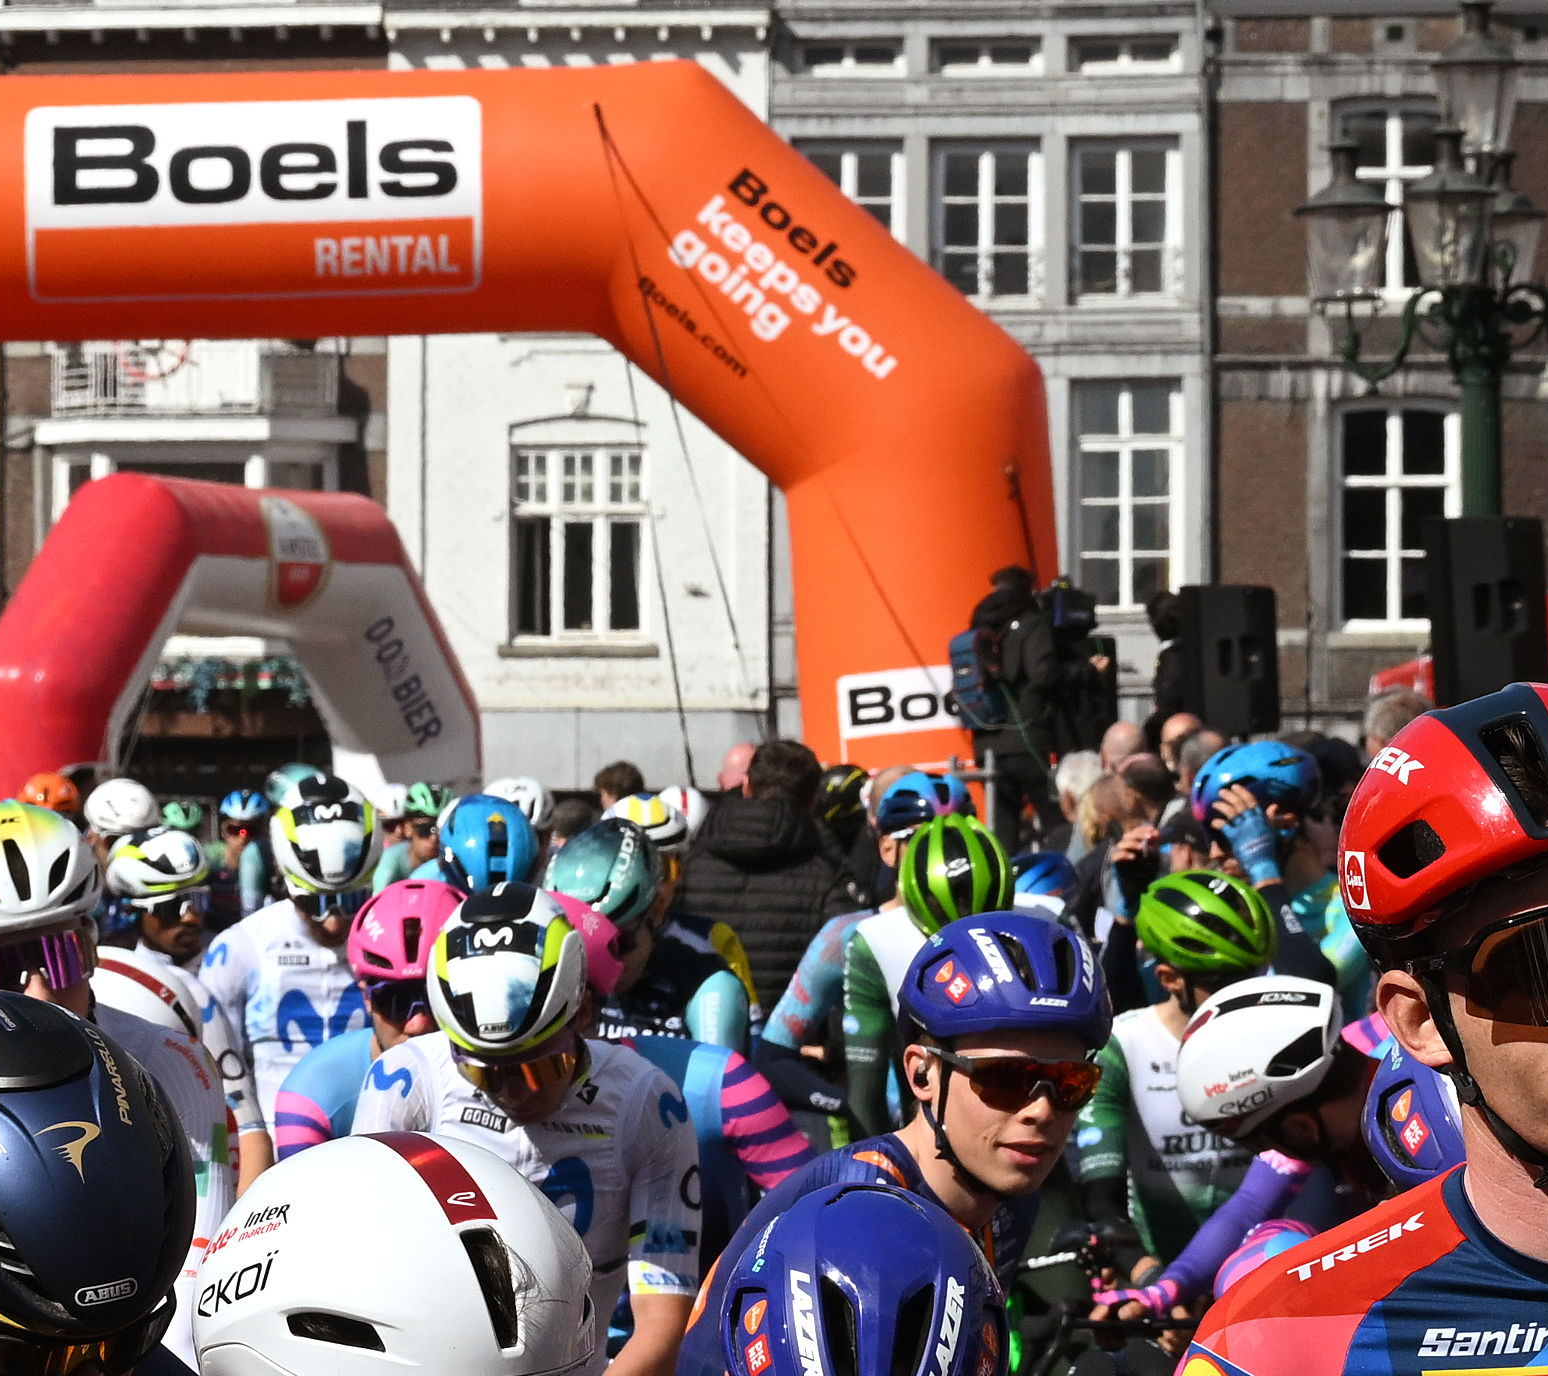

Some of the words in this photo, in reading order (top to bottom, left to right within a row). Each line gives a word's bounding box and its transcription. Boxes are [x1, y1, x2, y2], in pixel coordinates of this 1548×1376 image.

[51, 119, 460, 208] Boels
[313, 233, 461, 279] RENTAL
[726, 165, 859, 291] Boels
[668, 227, 791, 342] going
[696, 195, 827, 316] keeps
[812, 290, 899, 381] you
[393, 675, 442, 748] BIER
[847, 684, 960, 726] Boe
[1029, 997, 1069, 1009] LAZER
[1287, 1210, 1425, 1281] TREK
[84, 1282, 130, 1304] ABUS
